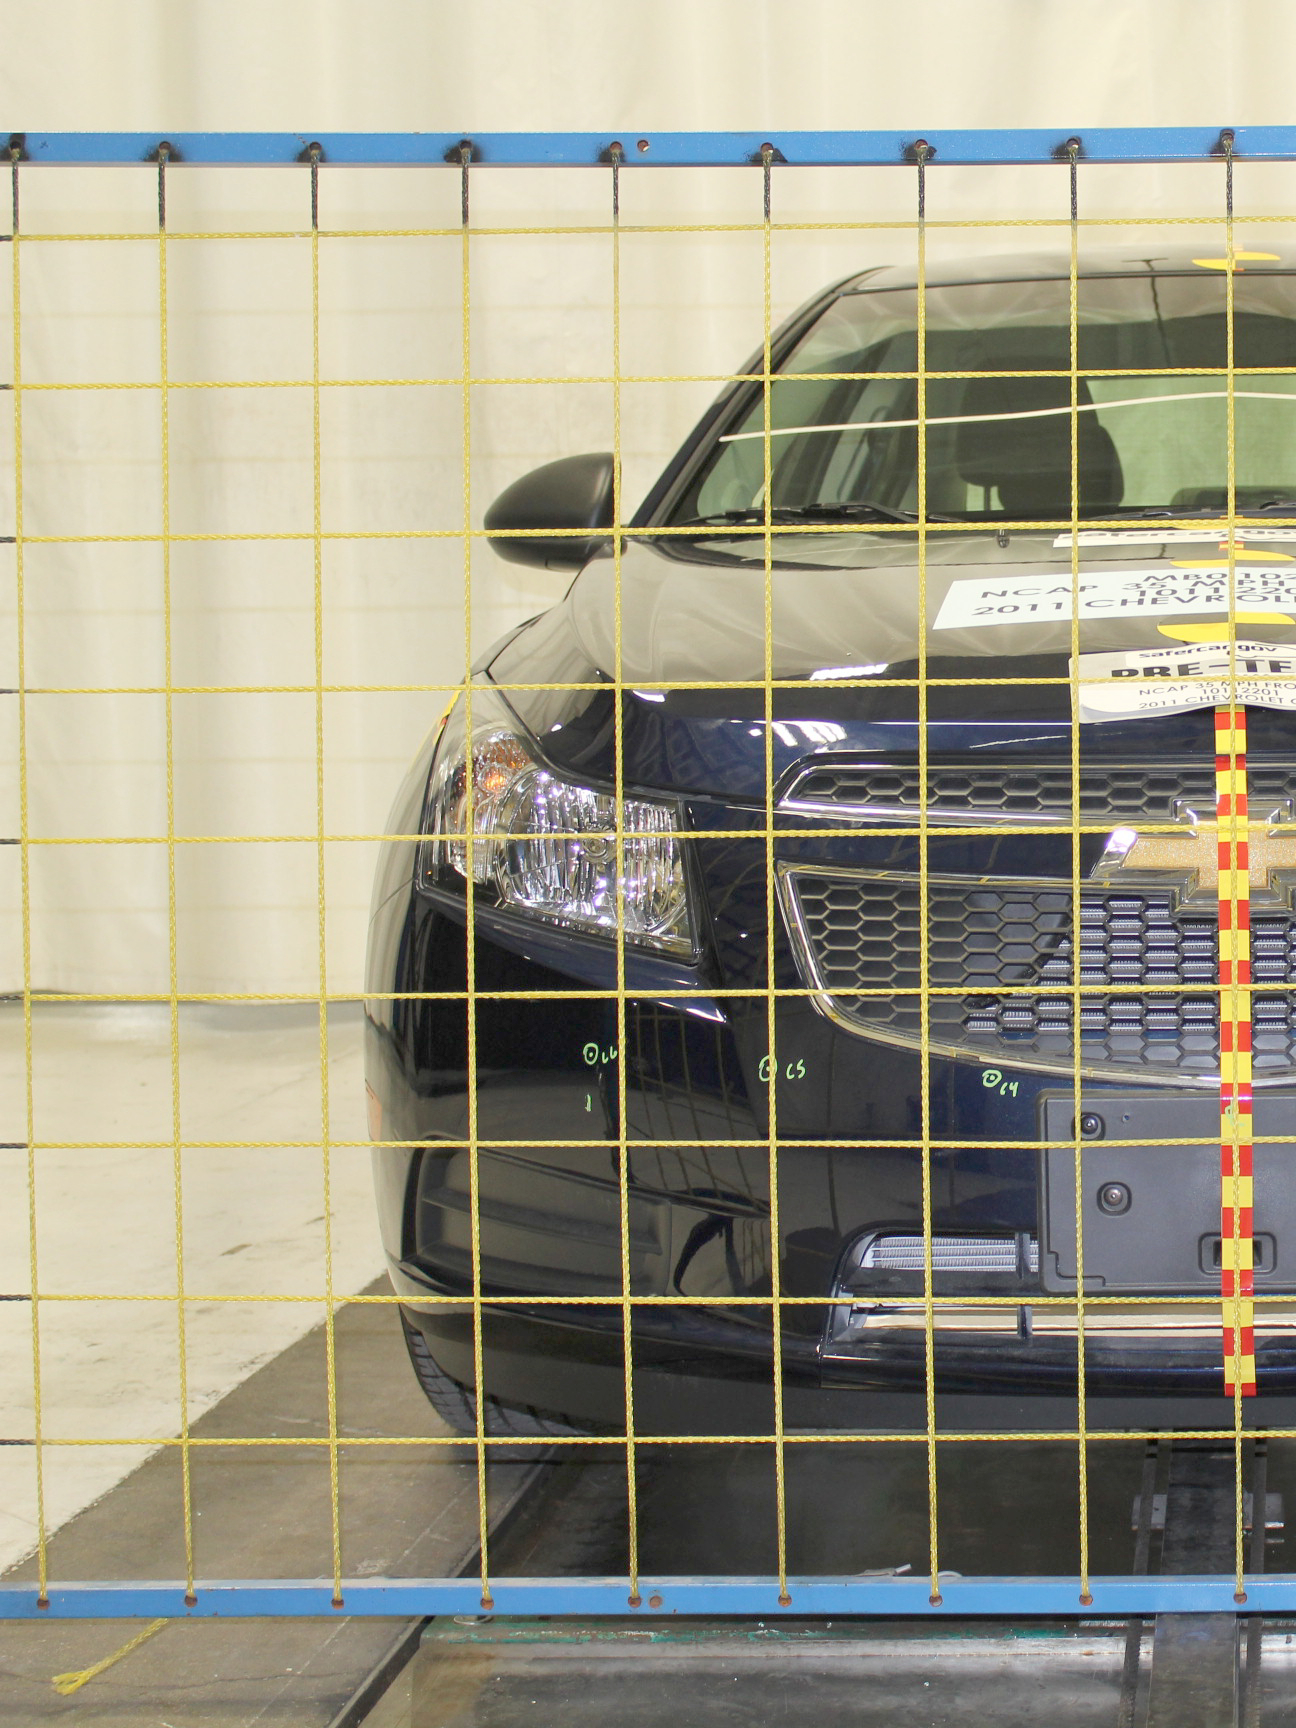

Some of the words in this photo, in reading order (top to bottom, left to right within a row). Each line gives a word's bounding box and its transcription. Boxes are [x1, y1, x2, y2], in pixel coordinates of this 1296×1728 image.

[981, 585, 1099, 599] NCAP
[1122, 582, 1168, 591] 35
[1191, 579, 1285, 588] MPH
[971, 602, 1064, 616] 2011
[1139, 685, 1189, 696] NCAP
[1139, 699, 1177, 709] 2011
[1185, 694, 1287, 704] CHEVROLET
